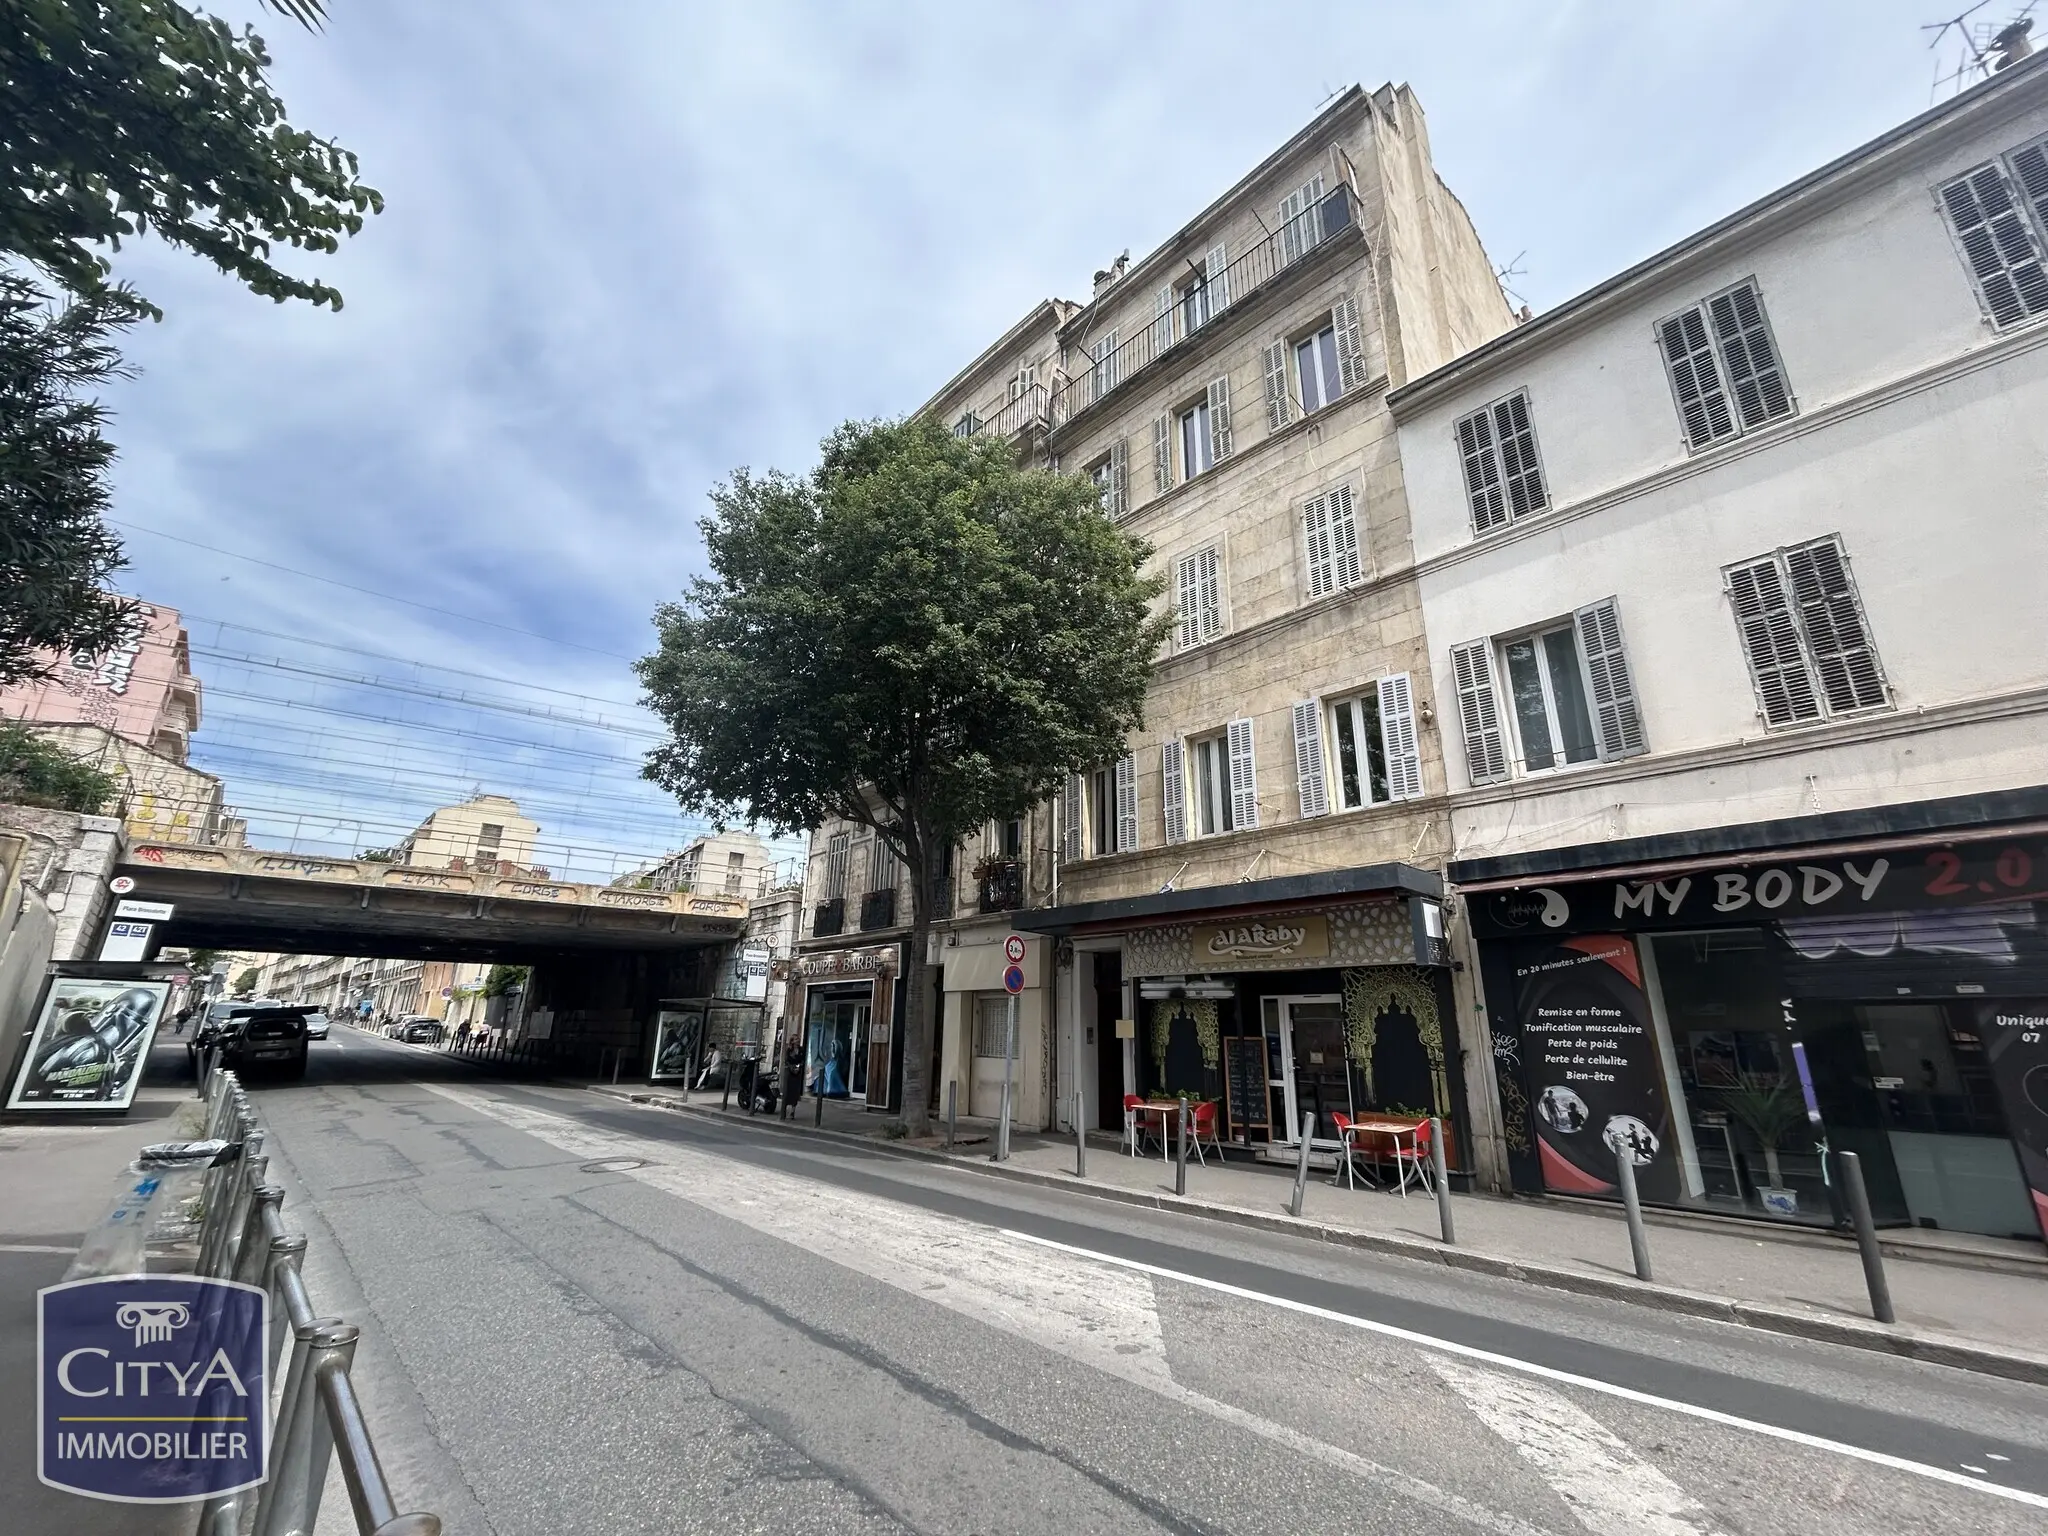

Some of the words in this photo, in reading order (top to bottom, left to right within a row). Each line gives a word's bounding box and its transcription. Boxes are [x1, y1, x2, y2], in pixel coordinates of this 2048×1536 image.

[1613, 877, 1691, 919] MY
[1713, 858, 1889, 912] BODY
[1924, 850, 2032, 896] 2.0
[802, 959, 835, 975] COUPE
[1517, 968, 1528, 976] En
[1530, 965, 1540, 973] 20
[1541, 958, 1574, 971] minutes
[1576, 949, 1620, 964] seulement
[1538, 1007, 1573, 1017] Remise
[1575, 1009, 1588, 1017] en
[1590, 1007, 1621, 1017] forme
[1525, 1022, 1582, 1032] Tonification
[1585, 1023, 1642, 1034] musculaire
[2022, 1032, 2041, 1043] 07
[1548, 1038, 1572, 1048] Perte
[1575, 1038, 1588, 1048] de
[1590, 1039, 1618, 1050] poids
[1545, 1054, 1570, 1063] Perte
[1572, 1054, 1585, 1064] de
[1588, 1055, 1628, 1066] cellulite
[1566, 1071, 1615, 1082] Bien-être
